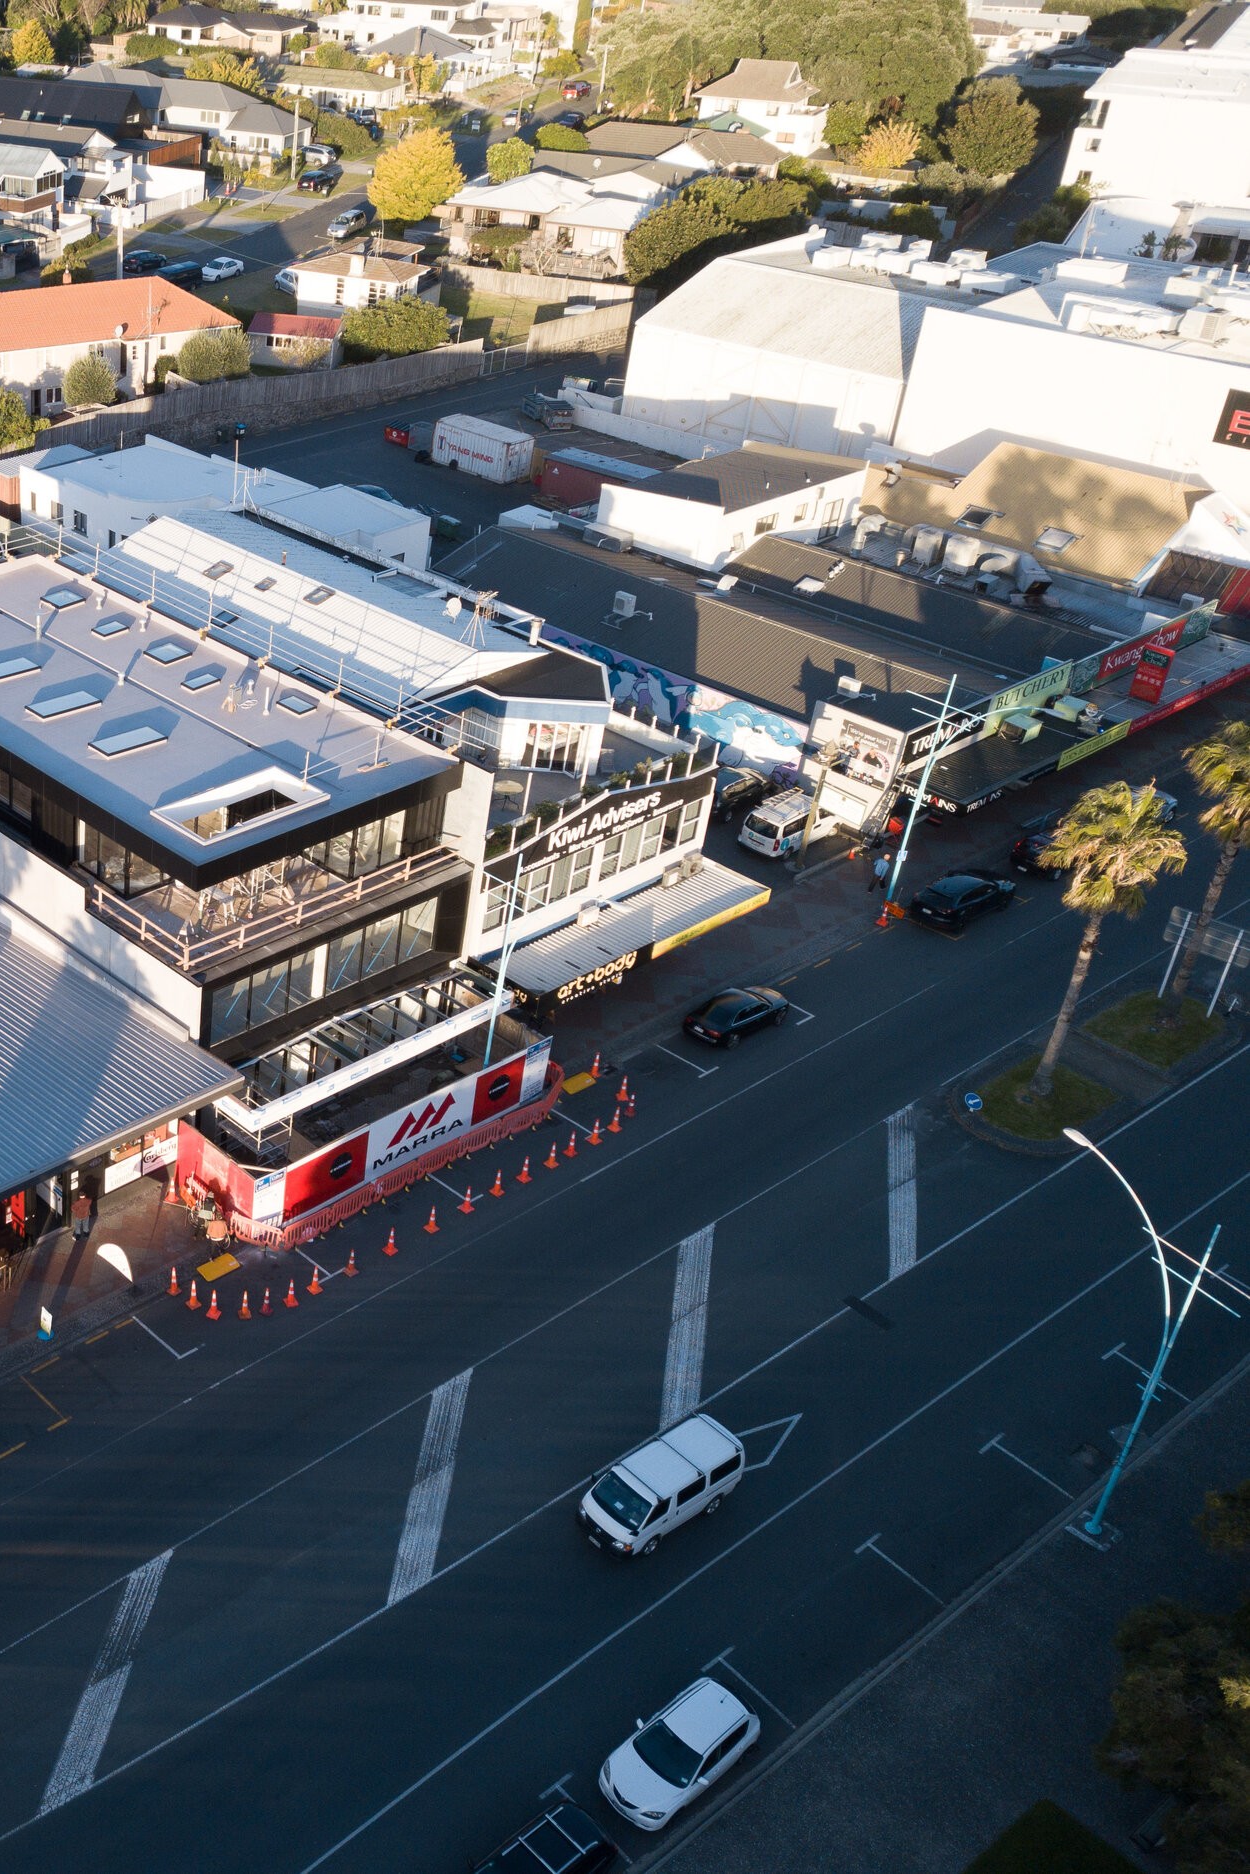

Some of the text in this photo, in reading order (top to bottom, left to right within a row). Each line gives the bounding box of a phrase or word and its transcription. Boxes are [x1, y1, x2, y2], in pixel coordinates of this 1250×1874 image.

[447, 442, 470, 457] YANG
[471, 450, 494, 464] MING
[1104, 644, 1145, 671] Kwang
[995, 668, 1068, 710] BUTCHERY
[548, 791, 662, 851] Kiwi Advisers
[143, 1142, 177, 1164] Carlsberg
[372, 1117, 464, 1170] MARRA
